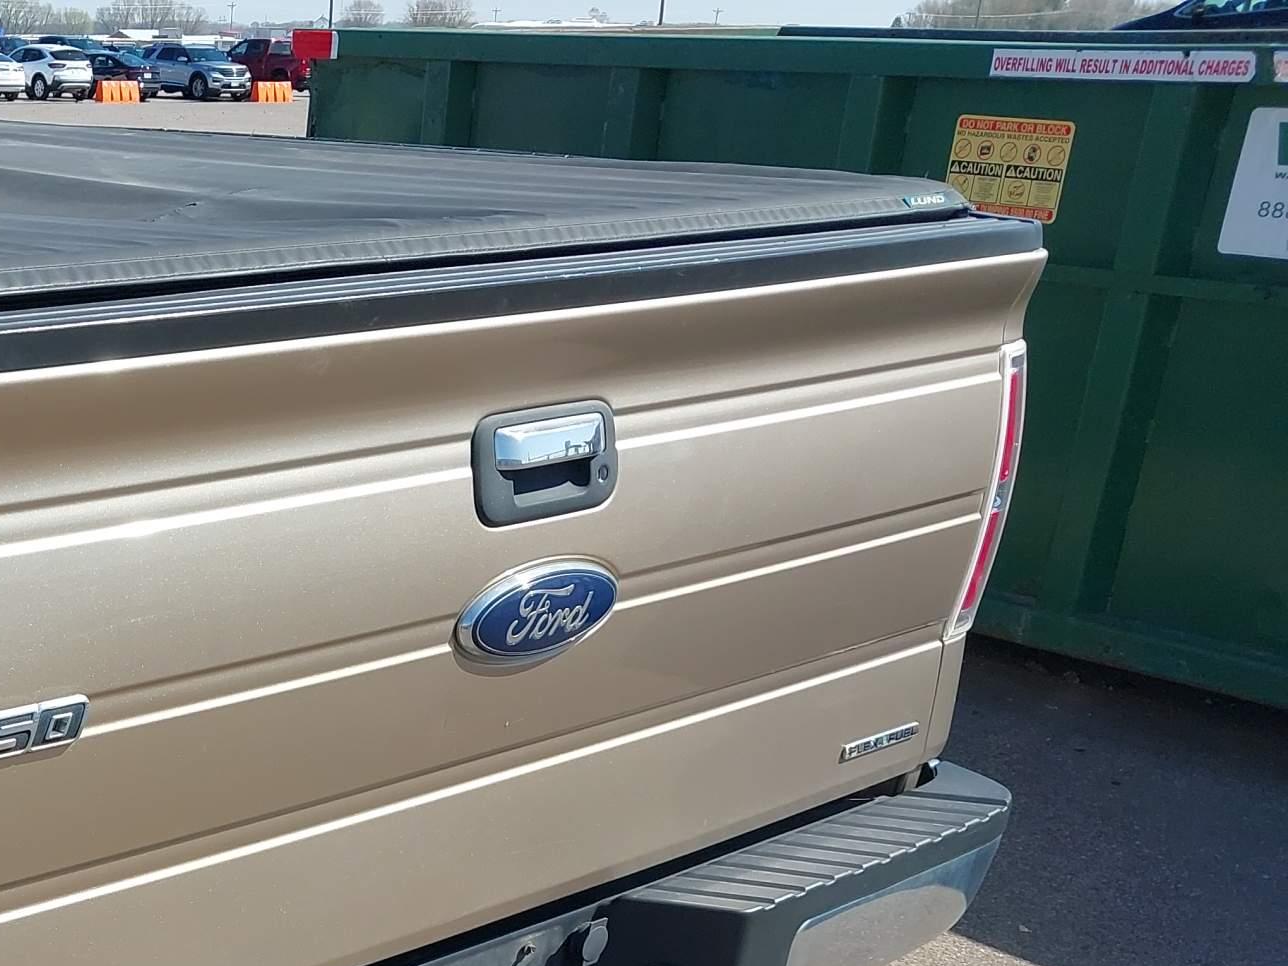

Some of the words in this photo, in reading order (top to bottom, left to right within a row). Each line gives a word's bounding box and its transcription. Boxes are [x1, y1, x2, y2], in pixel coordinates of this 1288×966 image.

[993, 56, 1053, 72] OVERFILLING
[1054, 58, 1077, 73] WILL
[1079, 59, 1118, 74] RESULT
[1118, 60, 1131, 74] IN
[1132, 59, 1195, 75] ADDITIONAL
[1197, 60, 1250, 76] CHARGES
[962, 119, 976, 129] DO
[976, 120, 995, 130] NOT
[995, 121, 1019, 132] PARK
[1020, 124, 1035, 133] OR
[1036, 125, 1069, 135] BLOCK
[1034, 136, 1070, 144] ACCEPTED
[960, 162, 1003, 176] CAUTION
[1016, 168, 1063, 181] CAUTION
[911, 196, 945, 205] LUND
[1257, 200, 1288, 219] 88
[505, 583, 594, 646] Ford
